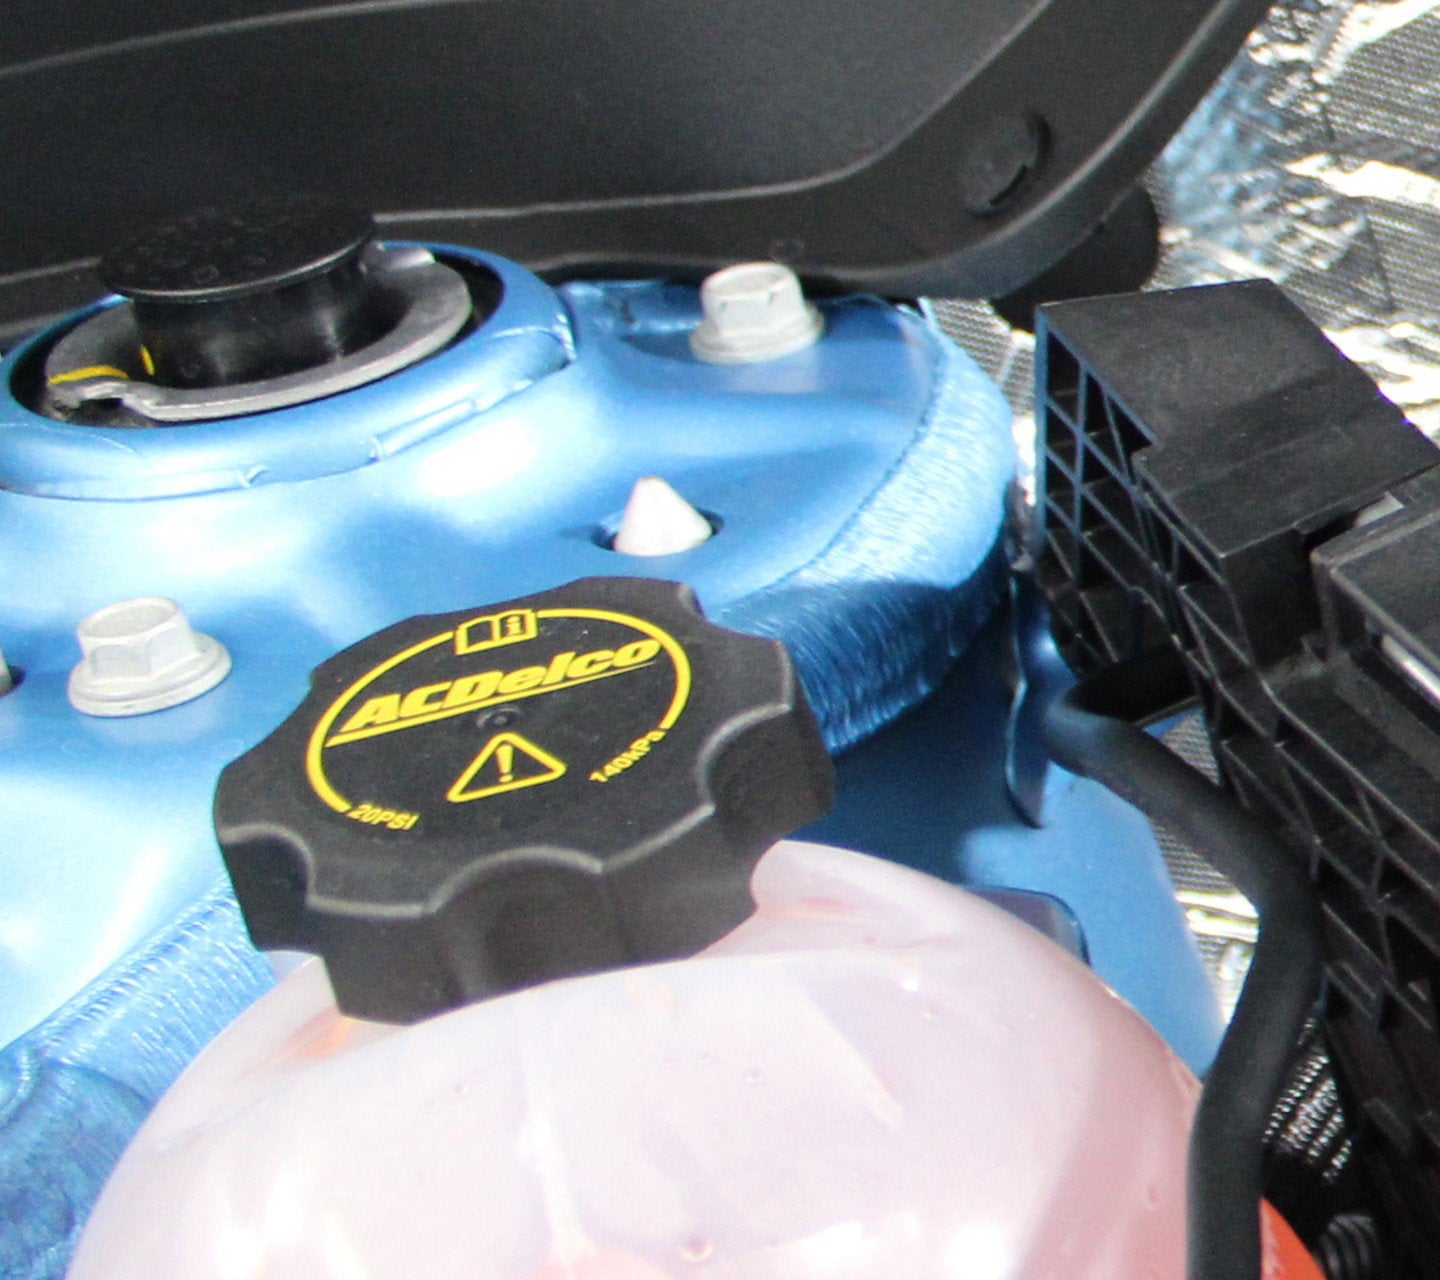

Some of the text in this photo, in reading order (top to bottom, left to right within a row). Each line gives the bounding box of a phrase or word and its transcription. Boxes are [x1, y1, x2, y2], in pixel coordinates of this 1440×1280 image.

[334, 638, 664, 737] ACDelco
[587, 727, 666, 785] 140kPa
[346, 802, 419, 832] 20PSI
